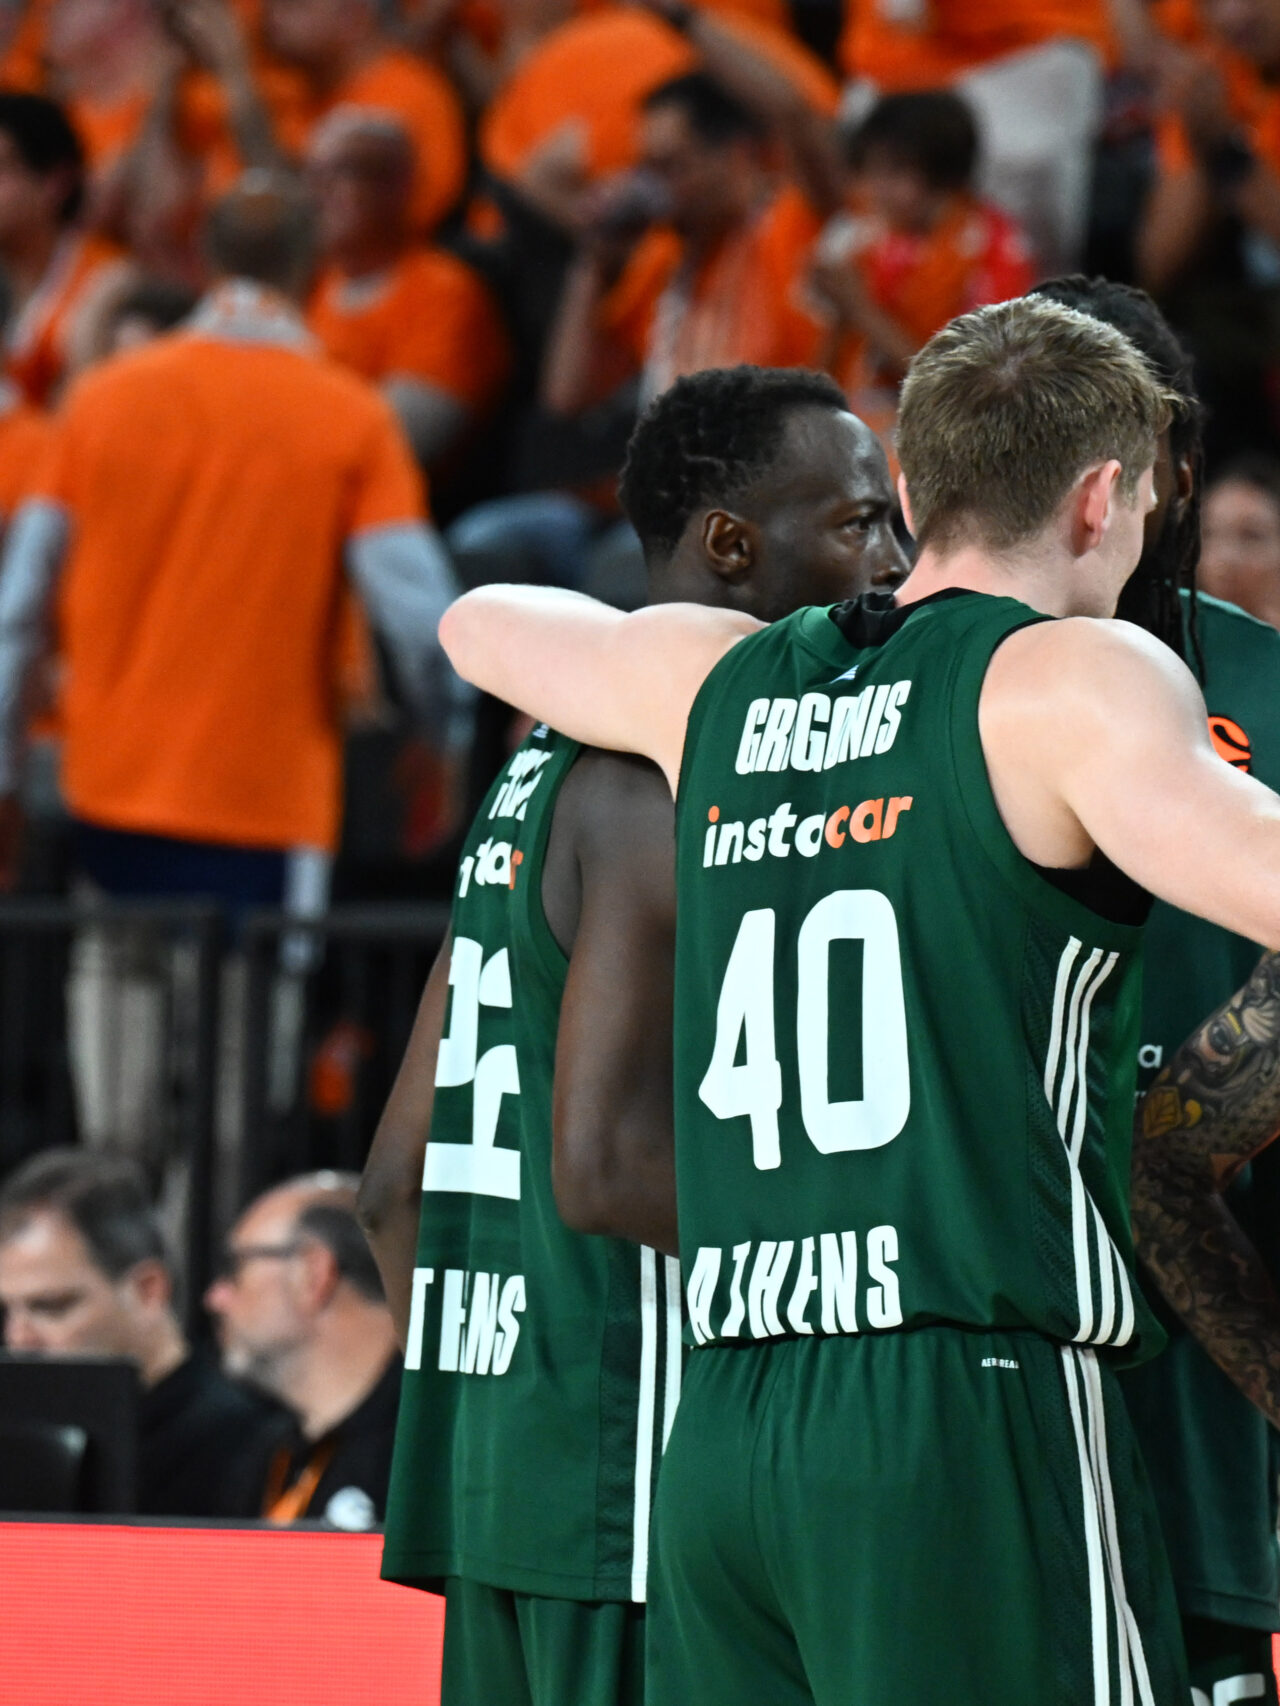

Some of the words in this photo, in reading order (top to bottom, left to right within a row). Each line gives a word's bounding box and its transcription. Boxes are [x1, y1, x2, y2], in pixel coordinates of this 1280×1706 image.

[702, 796, 913, 868] instacar
[698, 889, 911, 1170] 40
[686, 1225, 903, 1345] ATHENS
